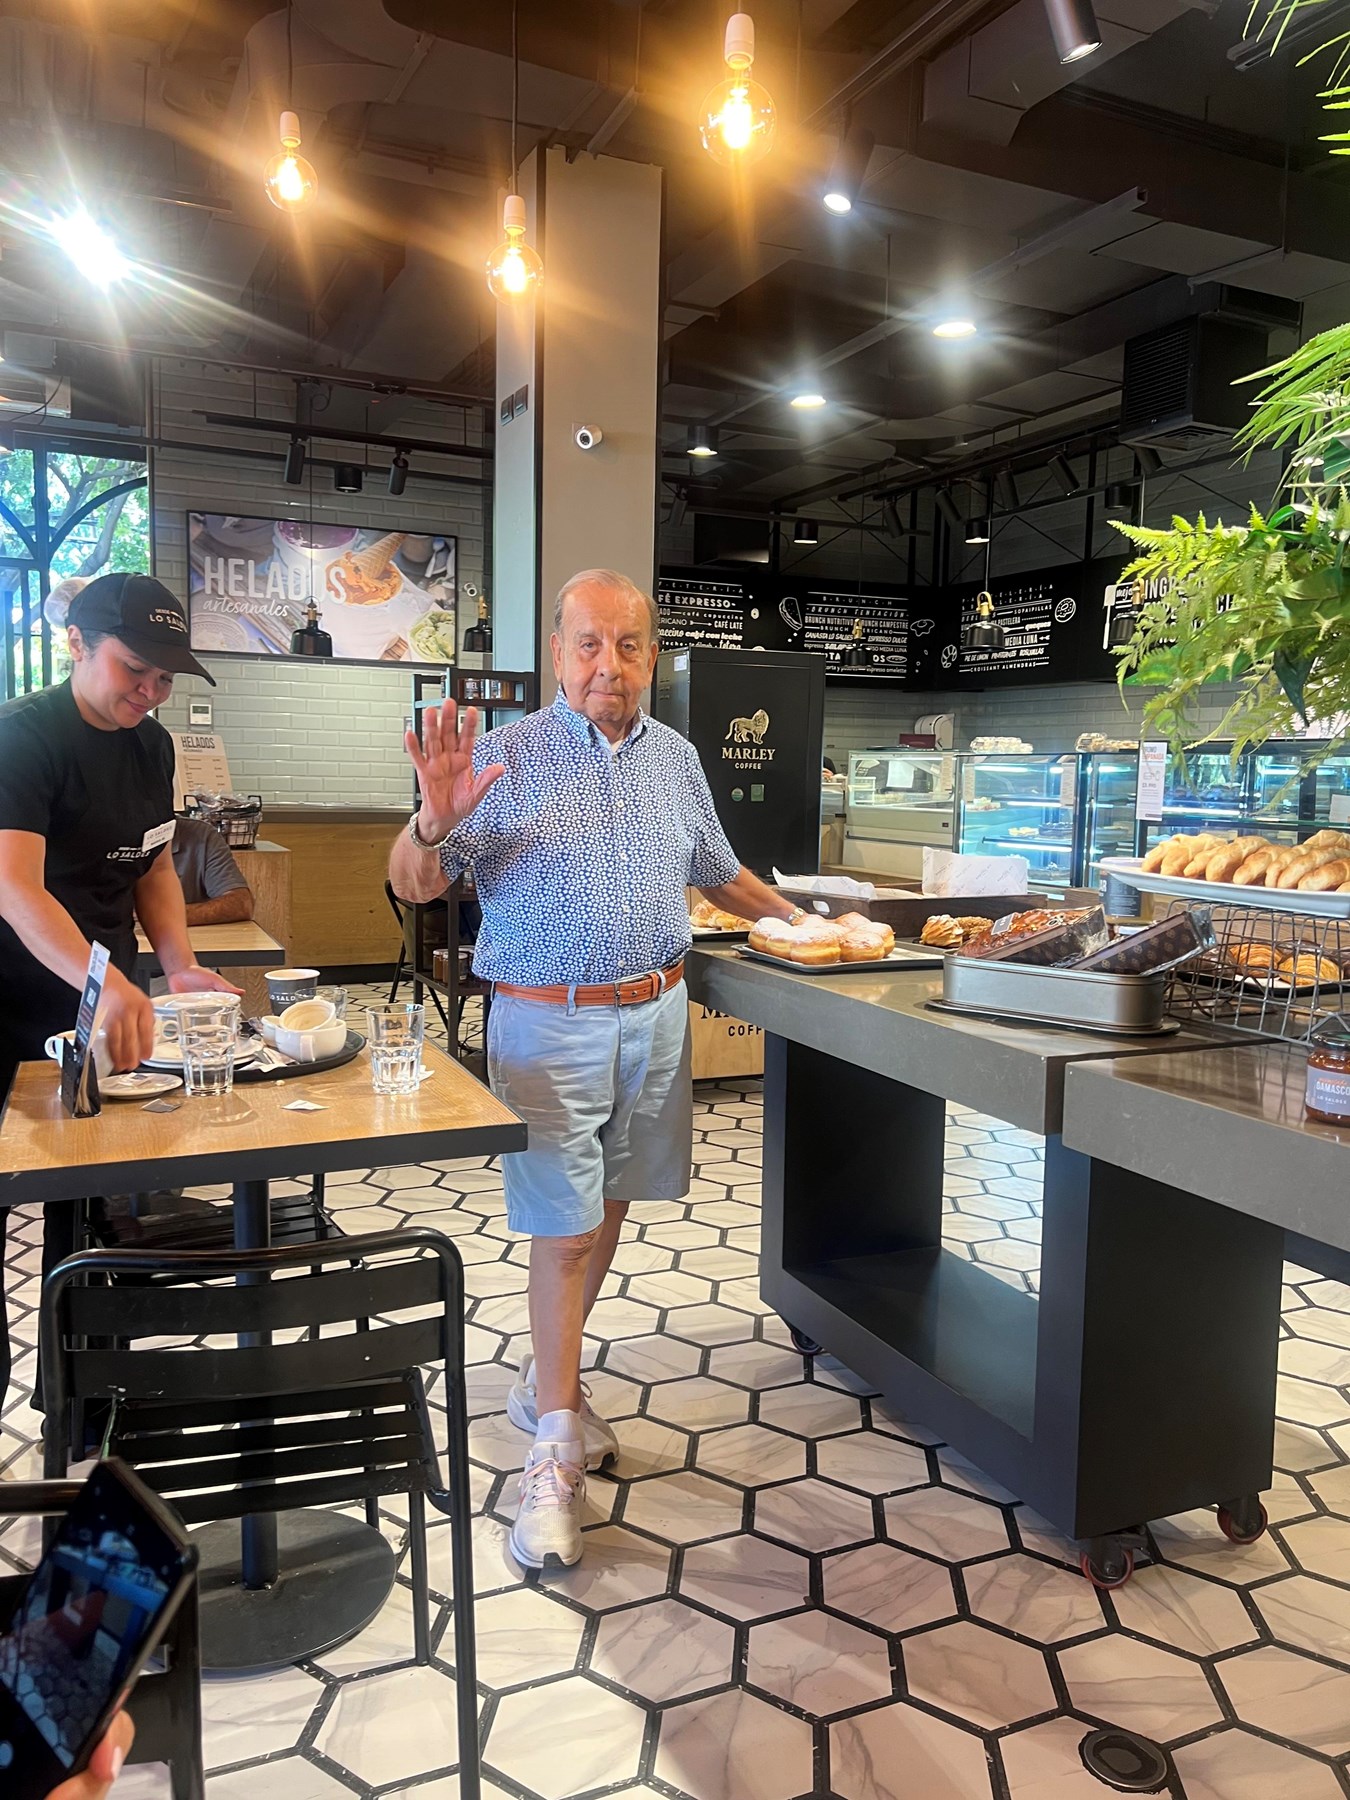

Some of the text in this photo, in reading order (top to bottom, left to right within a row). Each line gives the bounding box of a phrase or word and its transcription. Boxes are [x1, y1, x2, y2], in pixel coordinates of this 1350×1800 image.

[203, 555, 347, 606] HELADOS
[203, 597, 291, 617] artesanales
[1013, 604, 1053, 615] SOPAIPILLAS
[149, 614, 164, 623] LO
[714, 619, 728, 629] CAFÉ
[729, 621, 743, 630] LATE
[804, 615, 826, 624] BRUNCH
[879, 620, 909, 630] CAMPESTRE
[997, 616, 1021, 627] PASTELERA
[685, 630, 705, 640] café
[705, 632, 721, 640] con
[720, 632, 743, 641] leche
[804, 631, 827, 640] CANASTA
[891, 636, 908, 644] DULCE
[1004, 633, 1038, 647] MEDIA LUNA
[970, 661, 1037, 673] CROISSANT ALMENDRAS
[180, 735, 215, 749] HELADOS
[721, 747, 776, 761] MARLEY
[734, 762, 762, 770] COFFEE
[106, 851, 120, 859] LO
[1316, 1080, 1350, 1096] DAMASCO
